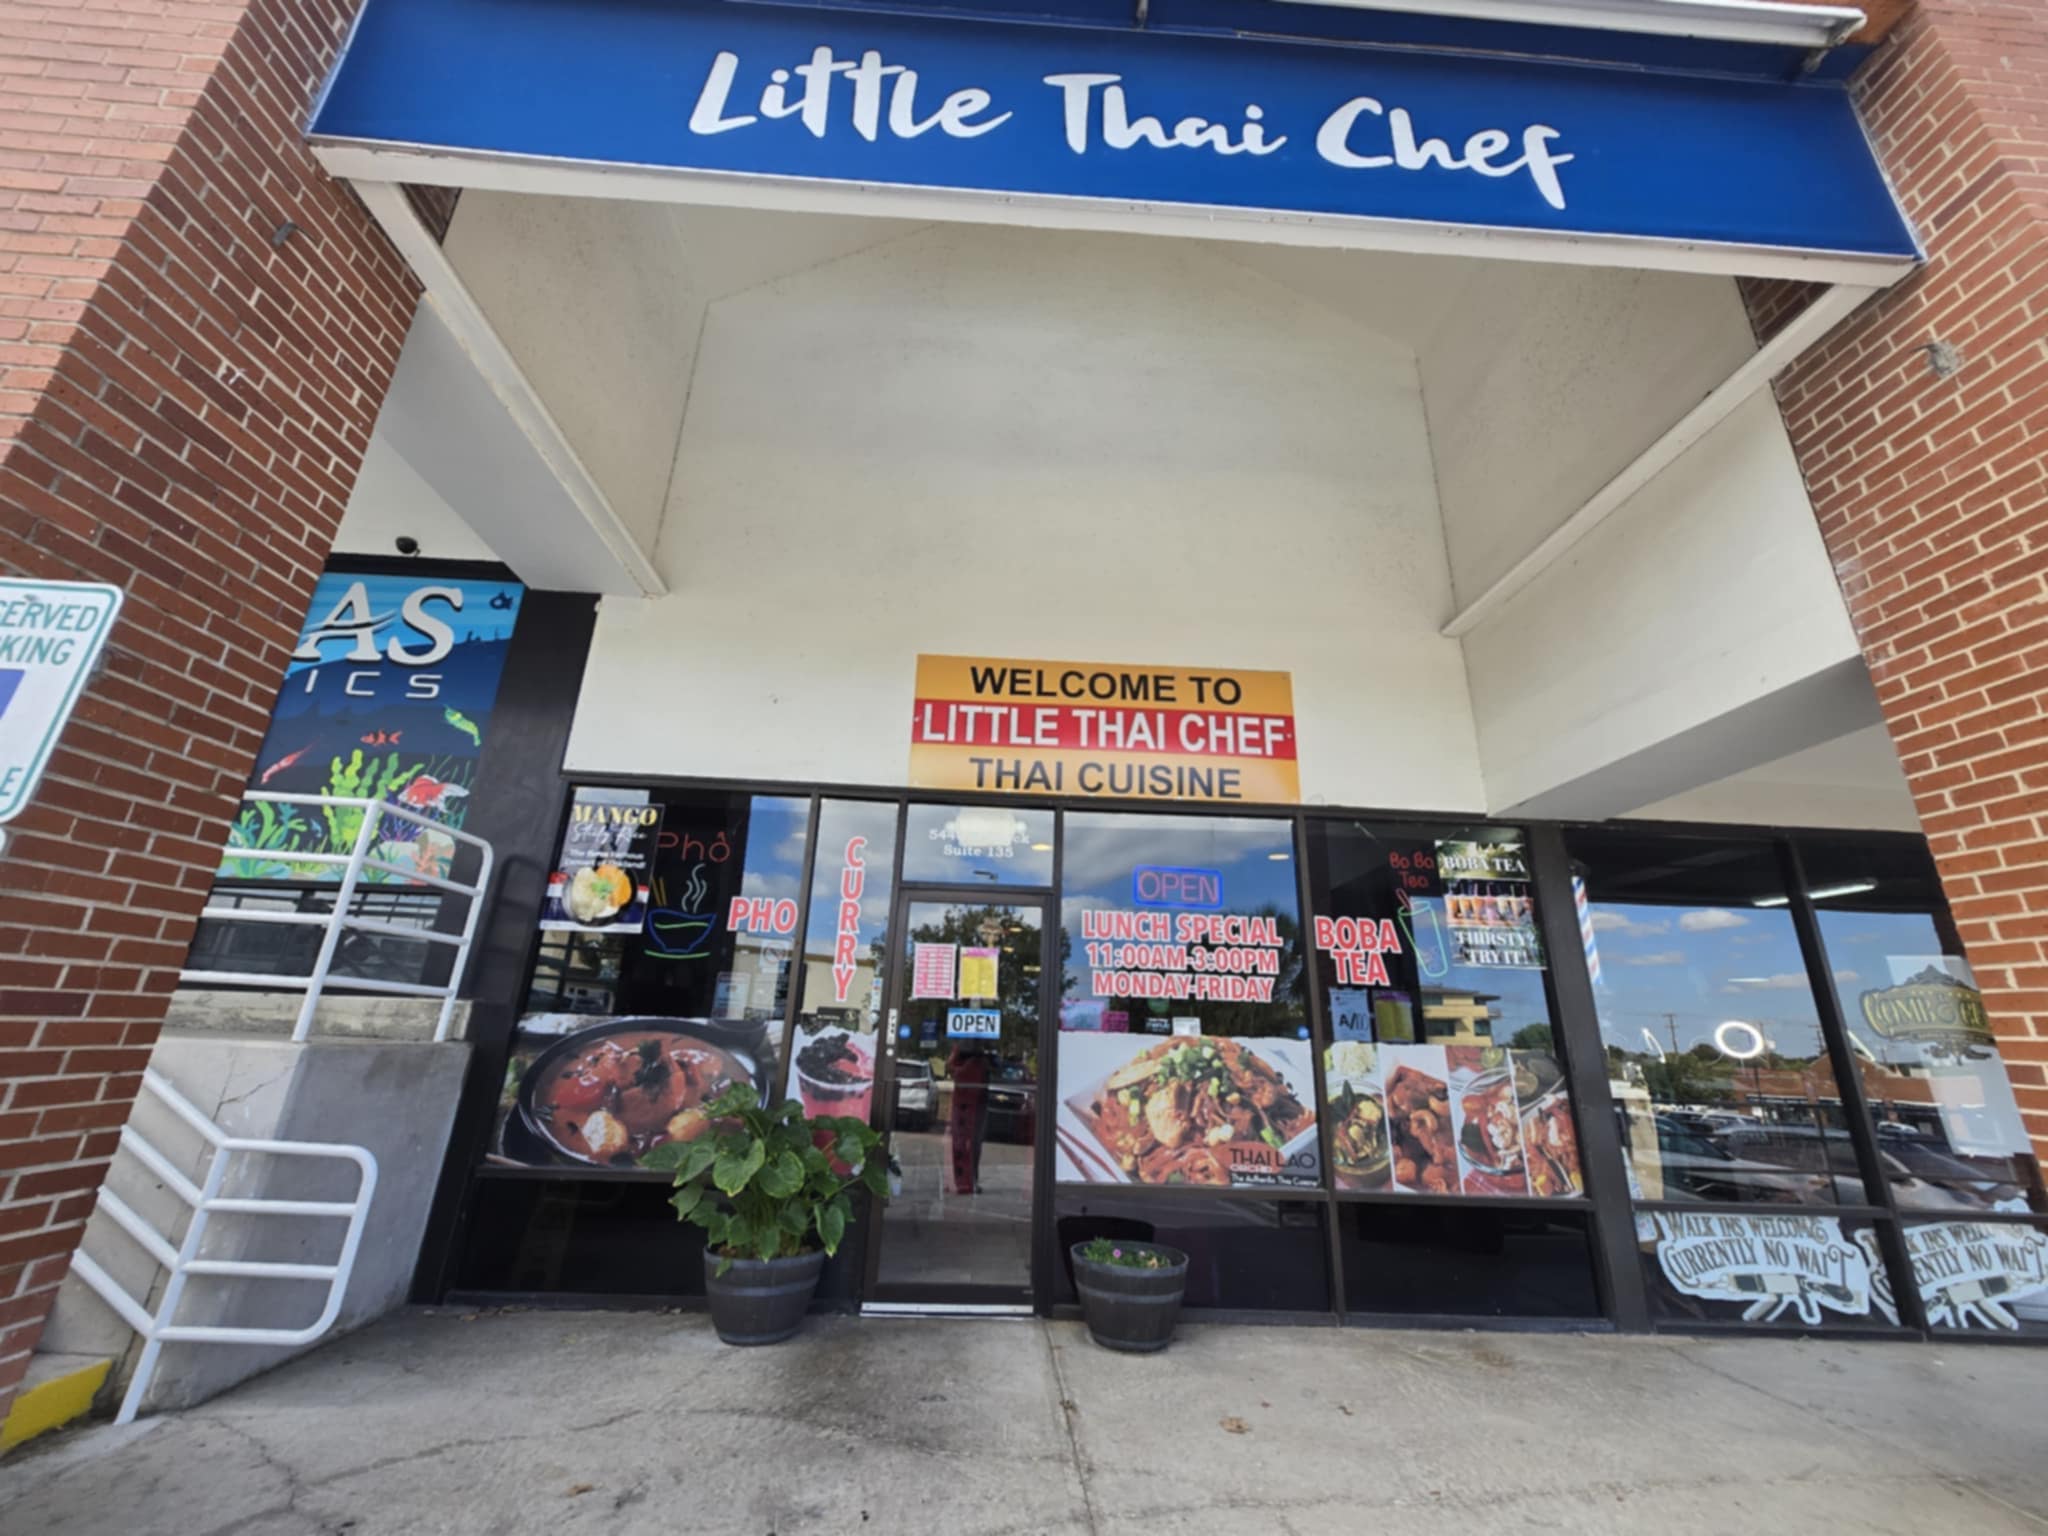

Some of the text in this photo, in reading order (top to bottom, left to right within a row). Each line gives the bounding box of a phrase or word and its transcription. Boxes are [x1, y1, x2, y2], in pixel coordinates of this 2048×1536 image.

[688, 45, 1574, 210] Little Thai Chef
[0, 599, 99, 633] ERVED
[0, 635, 76, 666] KING
[970, 666, 1242, 705] WELCOME TO
[922, 703, 1286, 756] LITTLE THAI CHEF
[970, 757, 1243, 799] THAI CUISINE
[574, 804, 658, 826] MANGO
[943, 844, 1014, 858] Suite 135
[1442, 856, 1526, 873] BOBA TEA
[1138, 871, 1219, 904] OPEN
[728, 896, 798, 933] PHO
[834, 836, 869, 1002] CURRY
[1081, 909, 1284, 948] LUNCH SPECIAL
[1313, 915, 1403, 954] BOBA
[1086, 942, 1280, 975] 11:00AM-3:00PM
[1330, 949, 1391, 987] TEA
[1466, 949, 1500, 965] TRY
[1092, 969, 1276, 1003] MONDAY-FRIDAY
[952, 1014, 996, 1033] OPEN
[1229, 1148, 1316, 1169] THAI LAO
[1666, 1211, 1717, 1240] WALK
[1718, 1216, 1746, 1238] INS
[1747, 1215, 1829, 1245] WELCOME
[1664, 1237, 1856, 1292] CURRENTLY NO WAIT
[1966, 1244, 1992, 1272] NO
